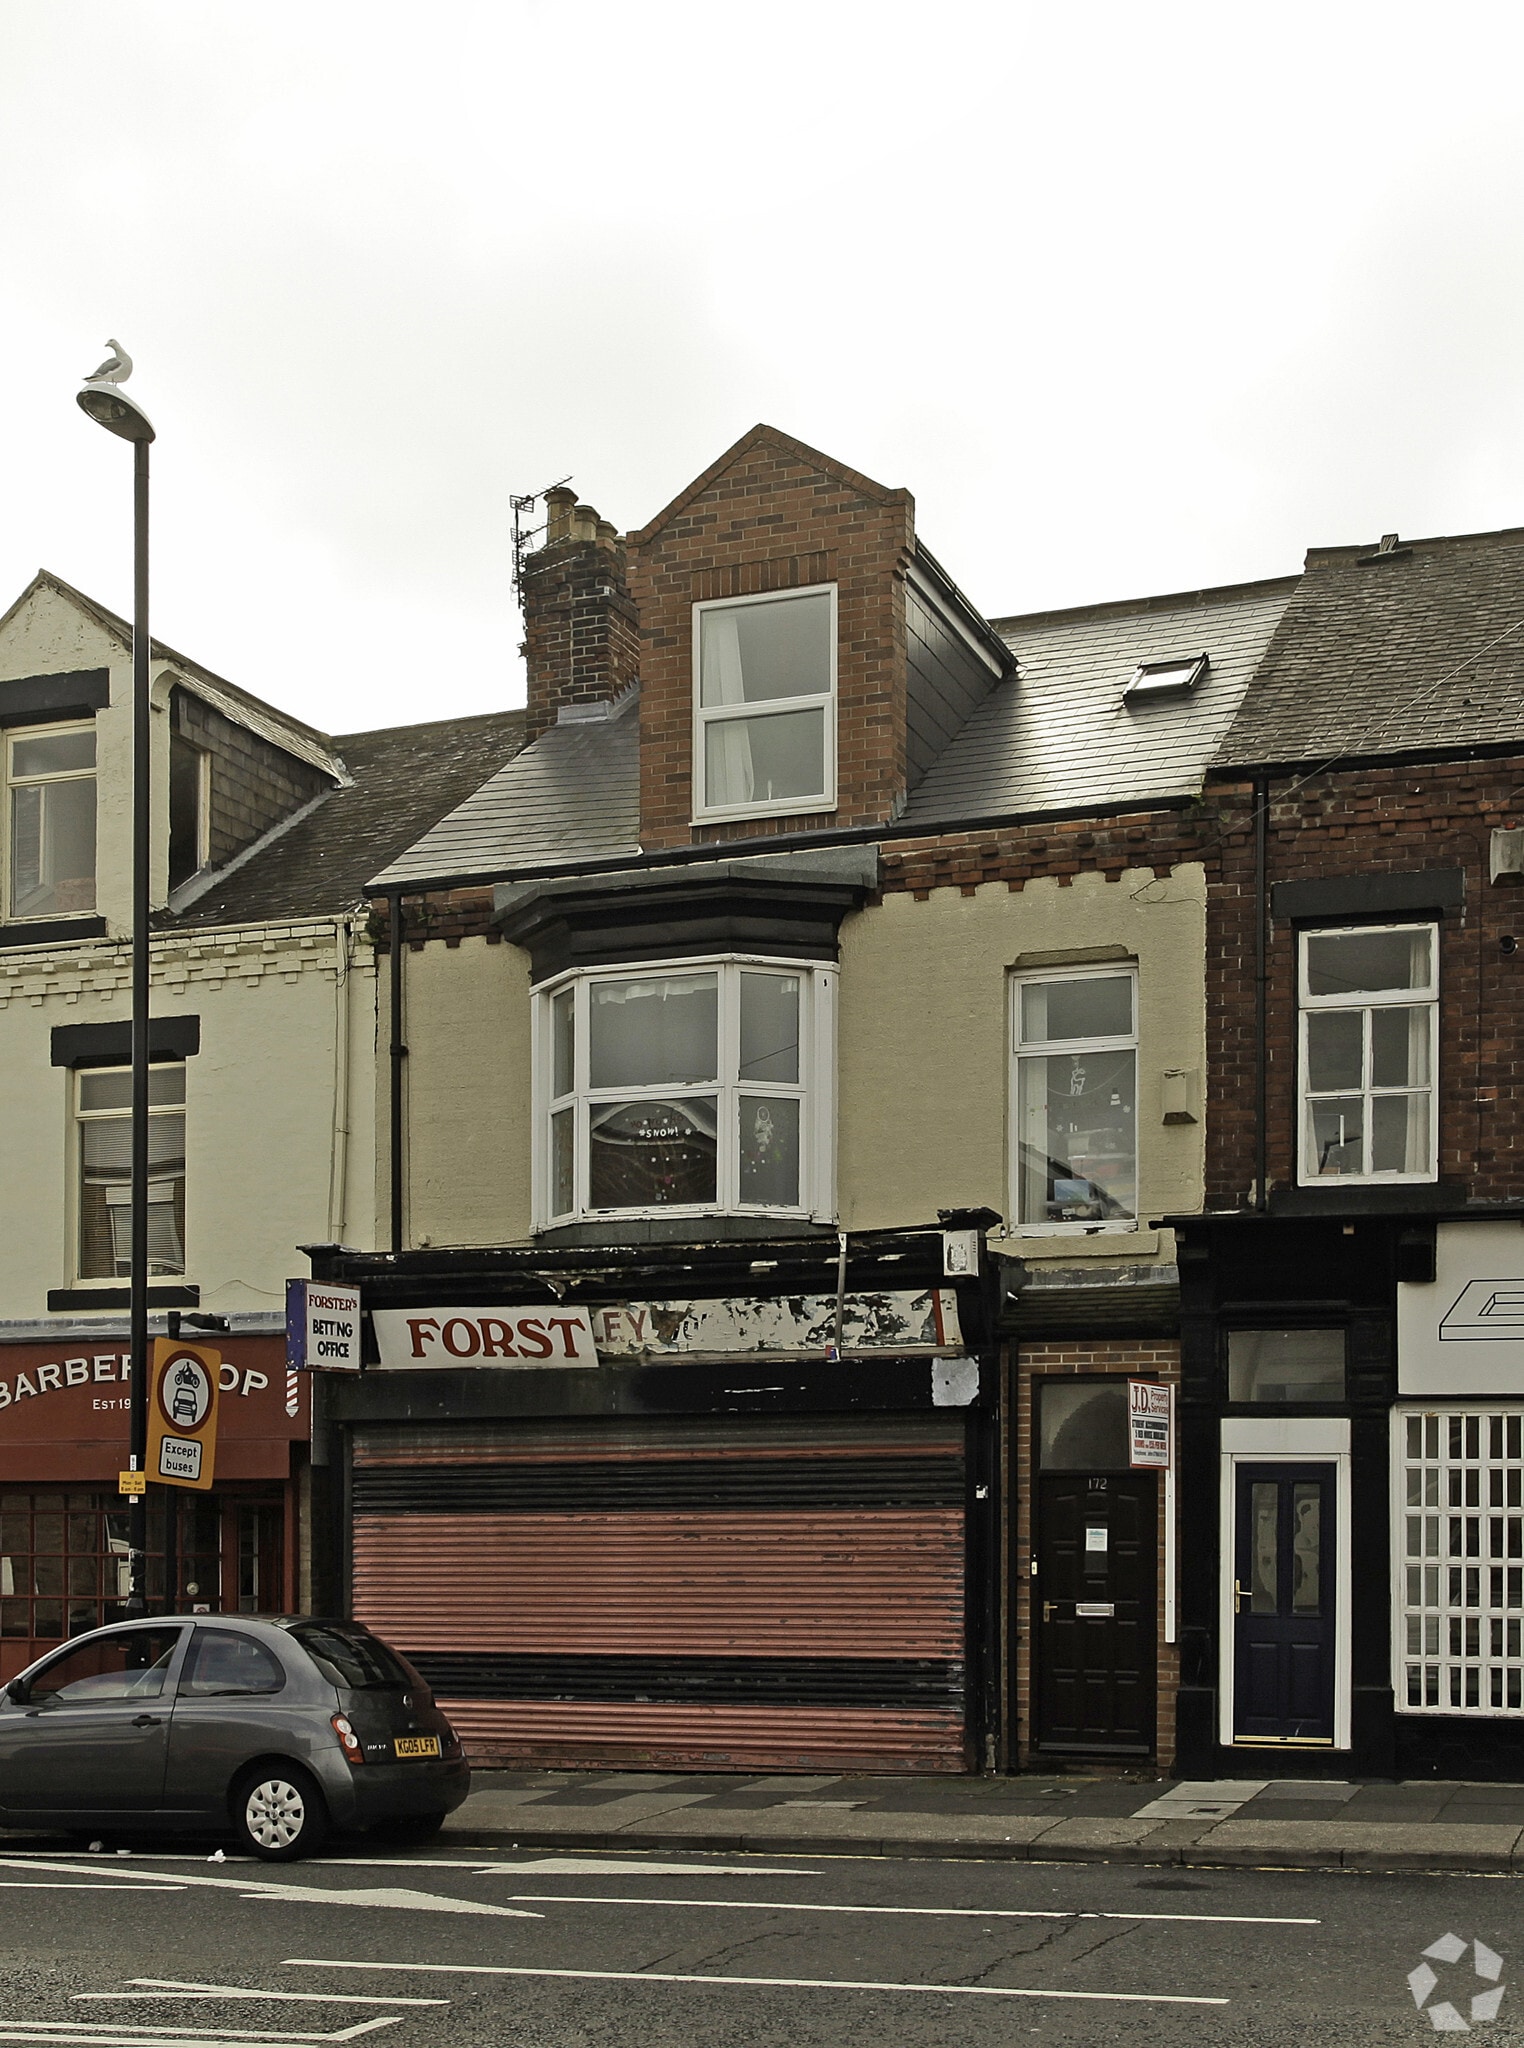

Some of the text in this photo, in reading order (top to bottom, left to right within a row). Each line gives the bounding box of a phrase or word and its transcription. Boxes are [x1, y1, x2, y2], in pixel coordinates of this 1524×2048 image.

[646, 1126, 679, 1138] SNOW!
[312, 1318, 353, 1338] BETTNG
[595, 1309, 647, 1344] EY
[406, 1317, 587, 1359] FORST
[317, 1340, 350, 1358] OFFICE
[218, 1363, 269, 1397] OP
[93, 1399, 114, 1410] EST
[165, 1442, 197, 1458] Except
[166, 1458, 193, 1473] buses
[1088, 1478, 1107, 1490] 172
[397, 1740, 420, 1754] KG05
[420, 1739, 436, 1752] LFR
